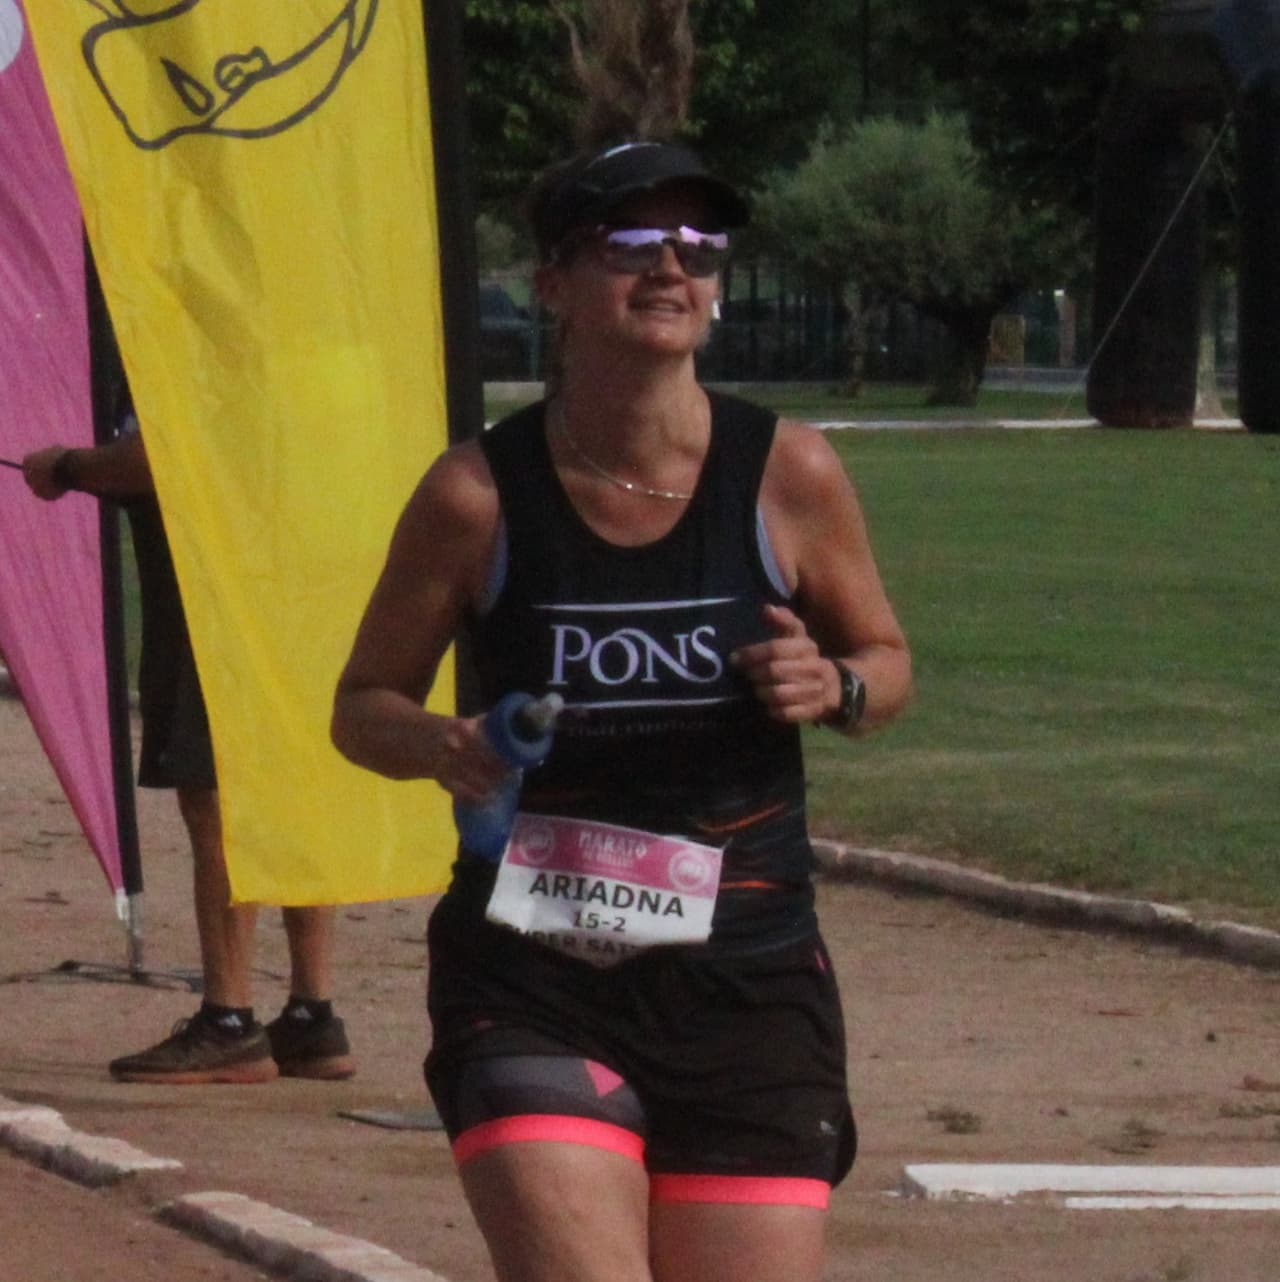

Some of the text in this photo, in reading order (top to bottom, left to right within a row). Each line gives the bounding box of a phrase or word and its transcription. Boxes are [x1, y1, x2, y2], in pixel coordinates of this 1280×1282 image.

[547, 624, 723, 685] PONS
[528, 873, 685, 918] ARIADNA
[573, 911, 627, 934] 15-2
